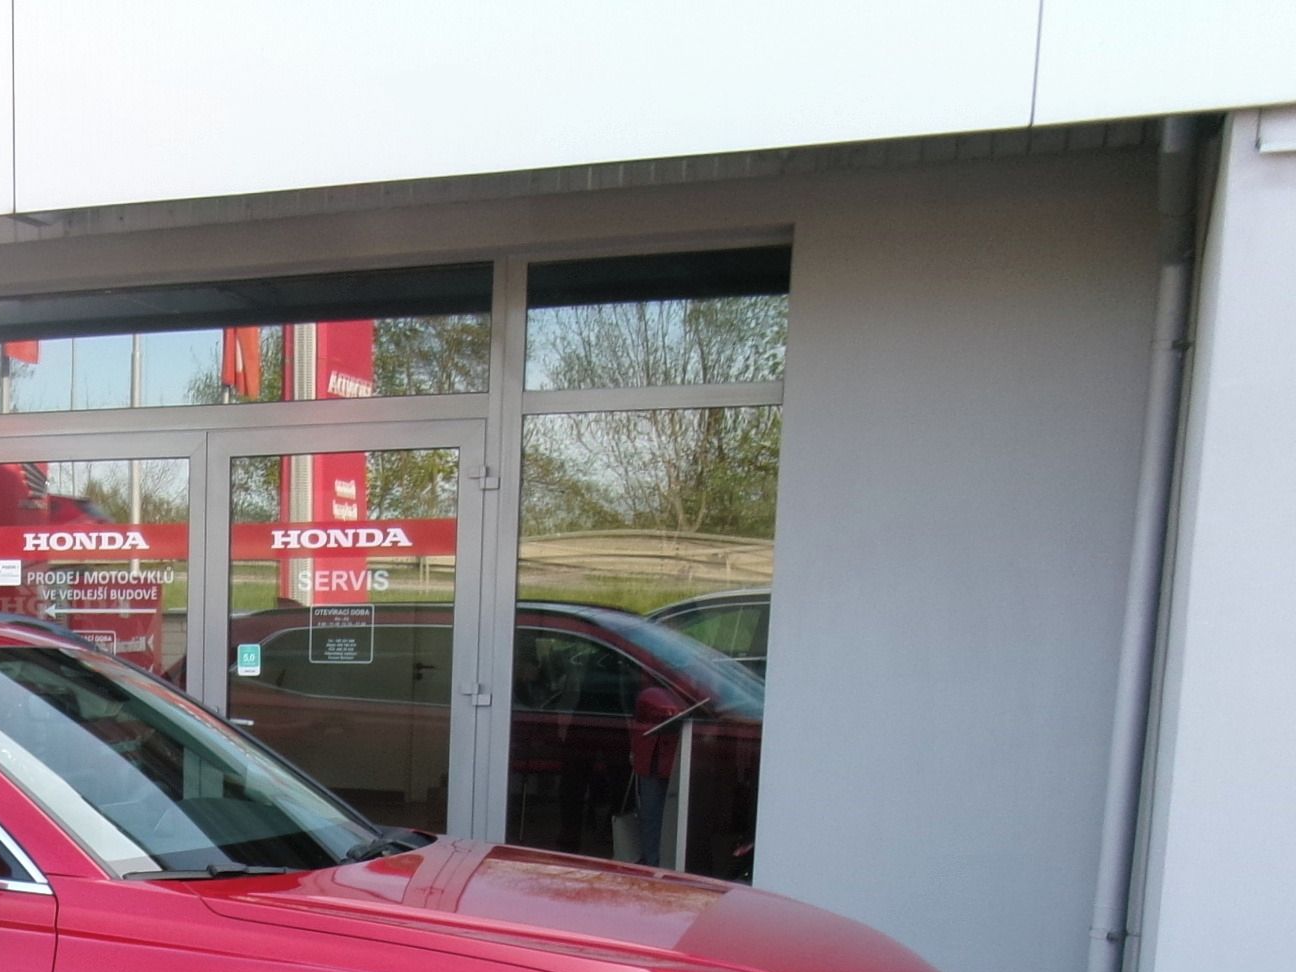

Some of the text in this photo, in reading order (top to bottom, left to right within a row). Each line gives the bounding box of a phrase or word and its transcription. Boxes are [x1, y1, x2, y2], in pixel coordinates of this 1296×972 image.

[23, 531, 150, 551] HONDA
[271, 528, 413, 549] HONDA
[26, 566, 175, 585] PRODEJ MOTOCYKLŮ
[298, 570, 390, 591] SERVIS
[42, 585, 158, 600] VE VEDLEJŠÍ BUDOVĚ
